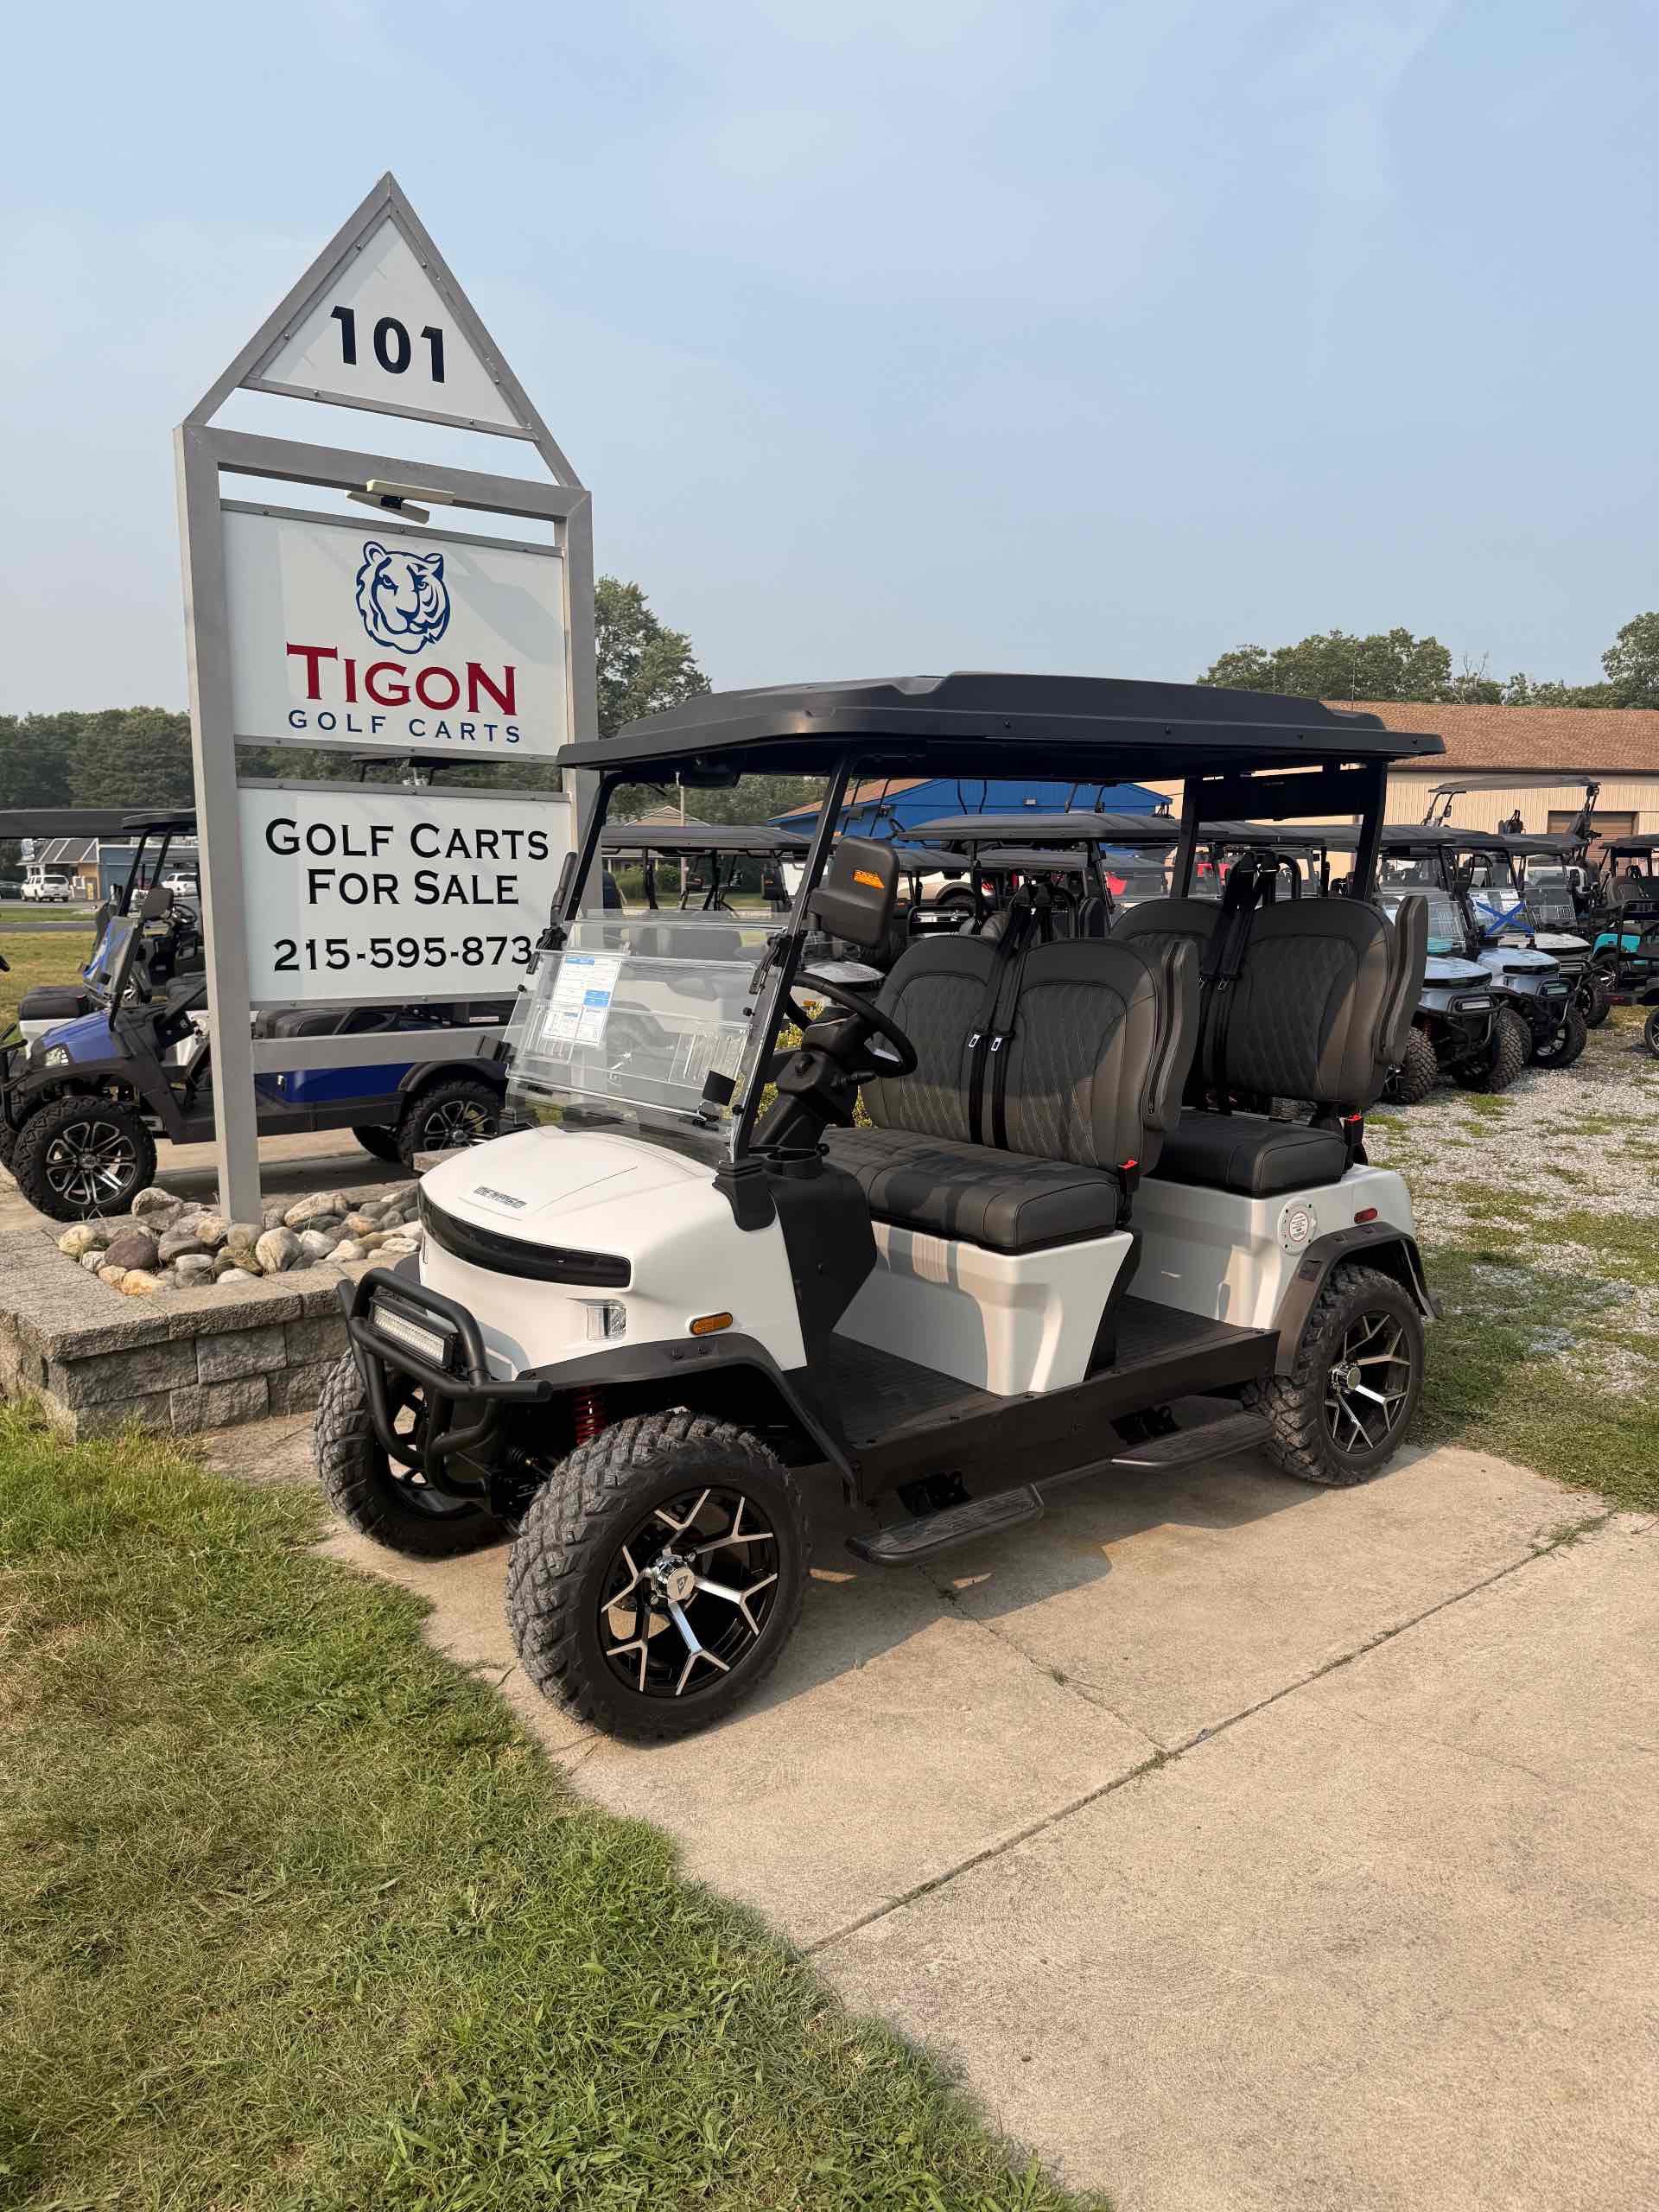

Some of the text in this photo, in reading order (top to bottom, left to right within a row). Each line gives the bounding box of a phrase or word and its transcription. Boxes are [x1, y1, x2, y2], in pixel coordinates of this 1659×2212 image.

[330, 305, 445, 384] 101
[286, 643, 517, 716] TIGON
[288, 709, 520, 744] GOLF CARTS
[265, 817, 549, 861] GOLF CARTS
[307, 868, 519, 906] FOR SALE
[273, 935, 533, 972] 215-595-873
